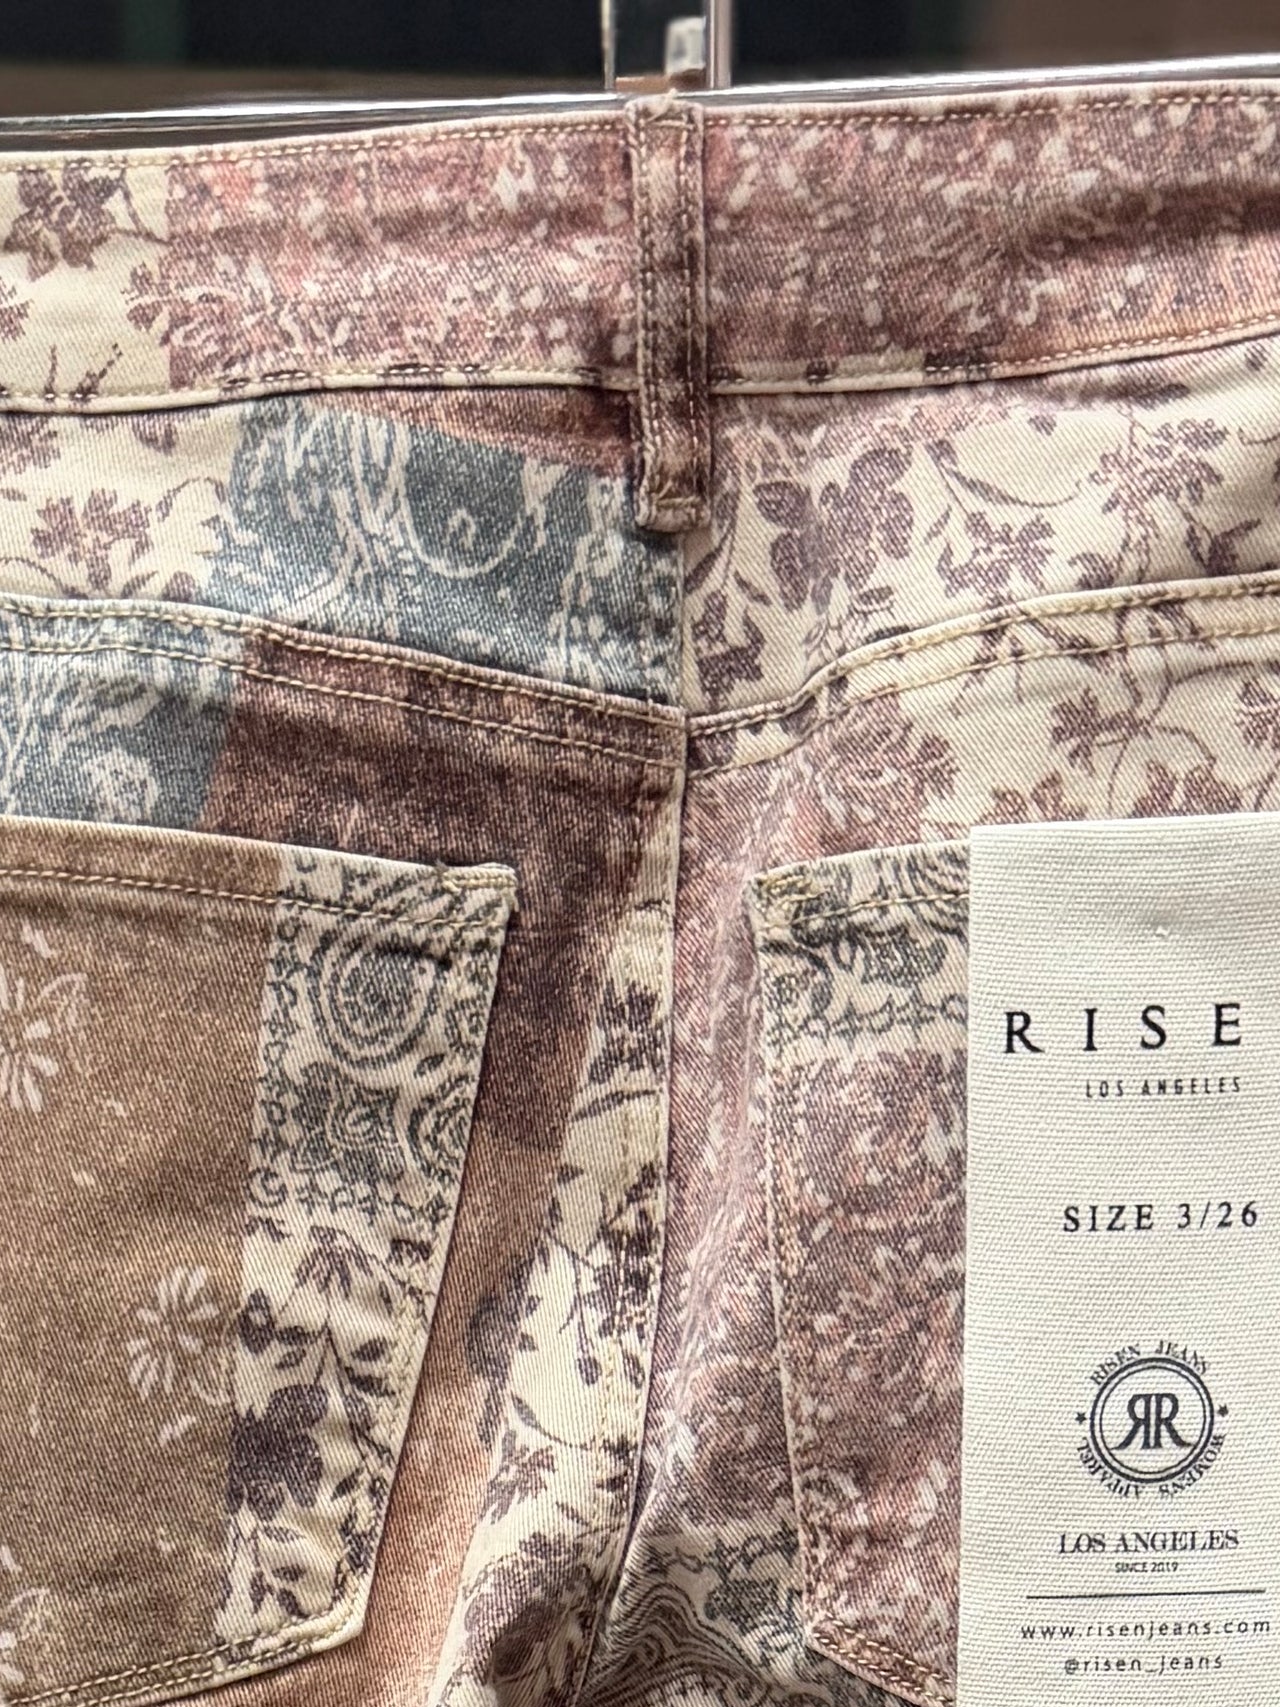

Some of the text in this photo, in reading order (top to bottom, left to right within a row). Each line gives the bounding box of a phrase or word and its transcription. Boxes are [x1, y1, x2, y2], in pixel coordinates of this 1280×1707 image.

[1086, 1076, 1241, 1098] LOS ANGELES
[1063, 1200, 1258, 1232] SIZE 3/26
[1089, 1342, 1142, 1386] RISEN
[1058, 1529, 1240, 1554] LOS ANGELES
[1115, 1561, 1179, 1573] SINCE 2019
[1021, 1620, 1271, 1641] www.risenjeans.com
[1064, 1655, 1222, 1675] @risen_jeans
